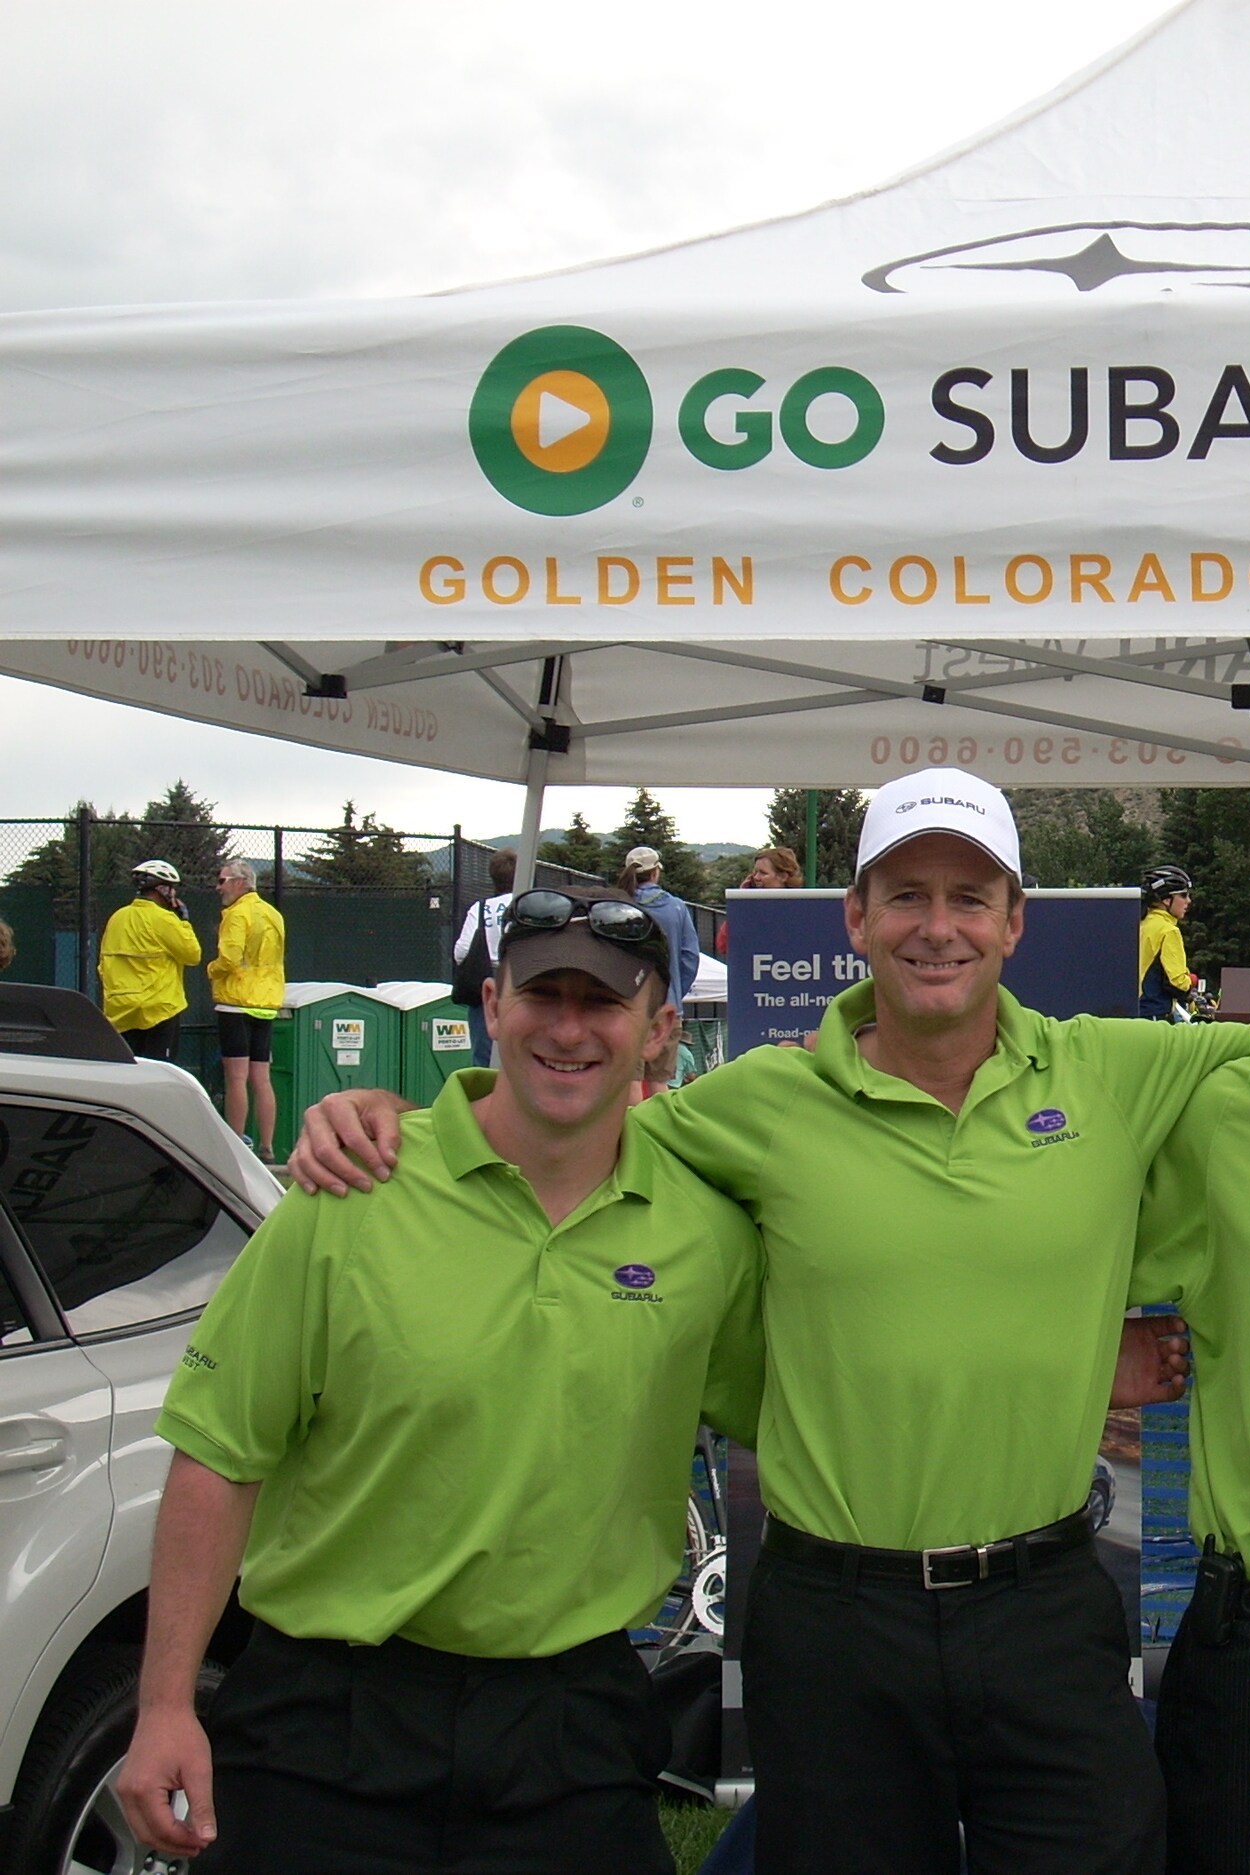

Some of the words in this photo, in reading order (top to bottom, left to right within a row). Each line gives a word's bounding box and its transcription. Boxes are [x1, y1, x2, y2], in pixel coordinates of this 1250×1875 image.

[678, 366, 885, 471] GO
[418, 555, 755, 606] GOLDEN
[920, 796, 986, 816] SUBARU
[753, 954, 821, 981] Feel
[754, 993, 785, 1007] The
[336, 1023, 361, 1033] WM
[436, 1024, 466, 1036] WM
[1031, 1131, 1080, 1148] SUBARU
[611, 1291, 662, 1303] SUBARU
